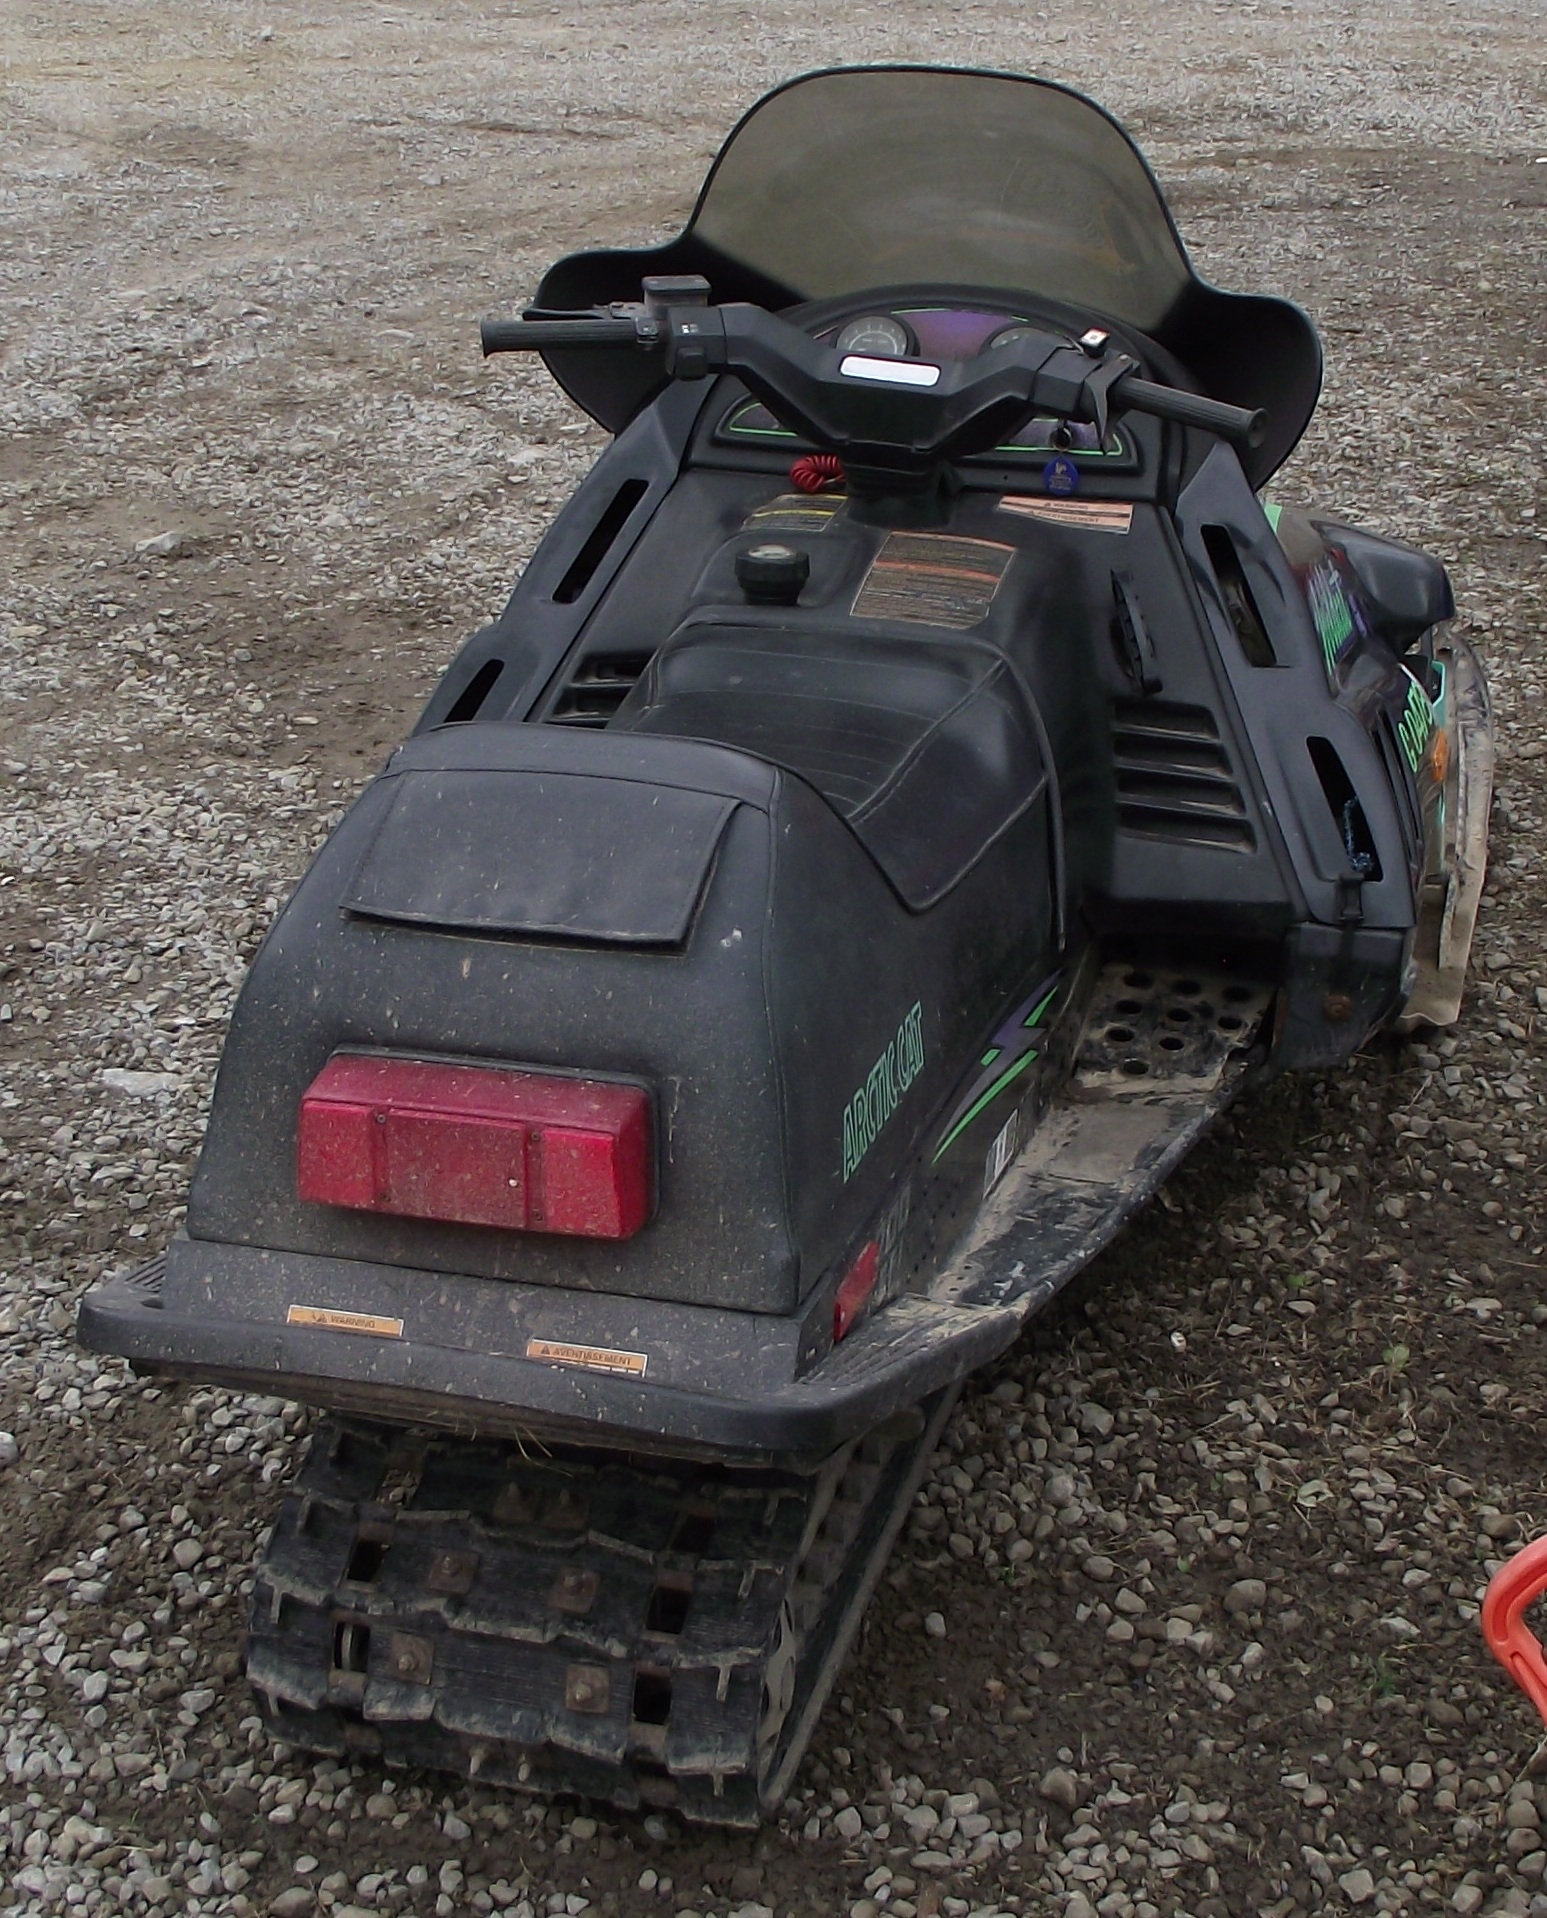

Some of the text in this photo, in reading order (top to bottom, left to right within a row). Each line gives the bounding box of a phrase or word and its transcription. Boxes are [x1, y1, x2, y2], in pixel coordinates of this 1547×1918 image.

[843, 1040, 898, 1184] ARCTIC
[897, 1000, 925, 1092] CAT
[331, 1314, 376, 1329] WARNING
